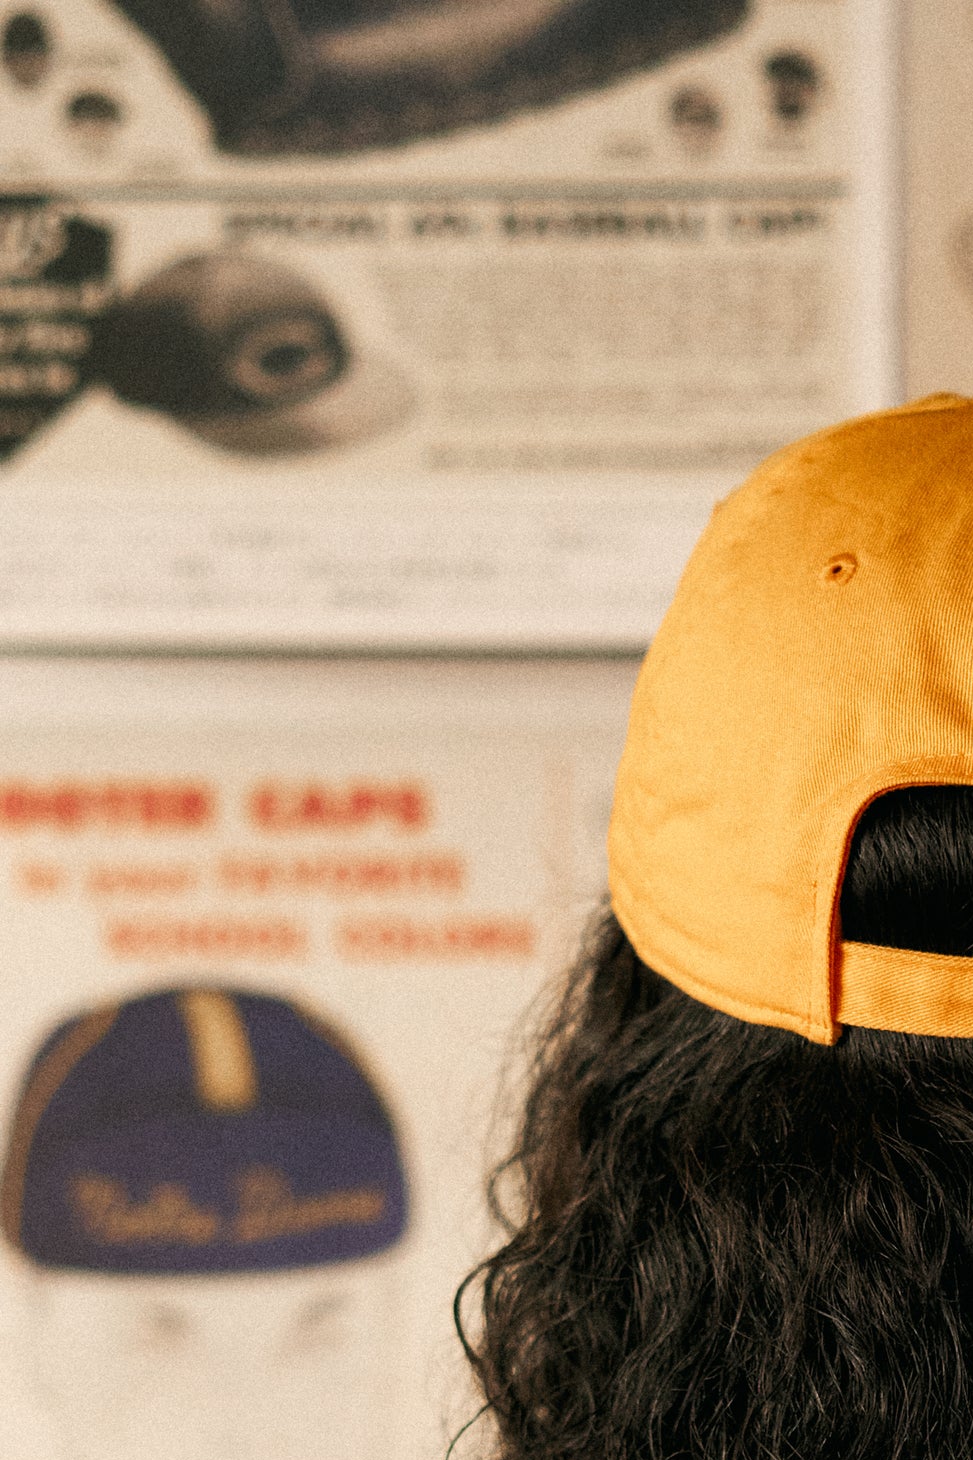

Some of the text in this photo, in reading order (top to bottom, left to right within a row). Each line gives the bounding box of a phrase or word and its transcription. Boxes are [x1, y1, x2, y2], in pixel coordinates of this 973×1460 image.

[502, 207, 702, 240] BASEBALL
[250, 780, 430, 832] CAPS
[217, 853, 464, 891] FAVORITE
[107, 918, 535, 957] SCHOOL COLORS
